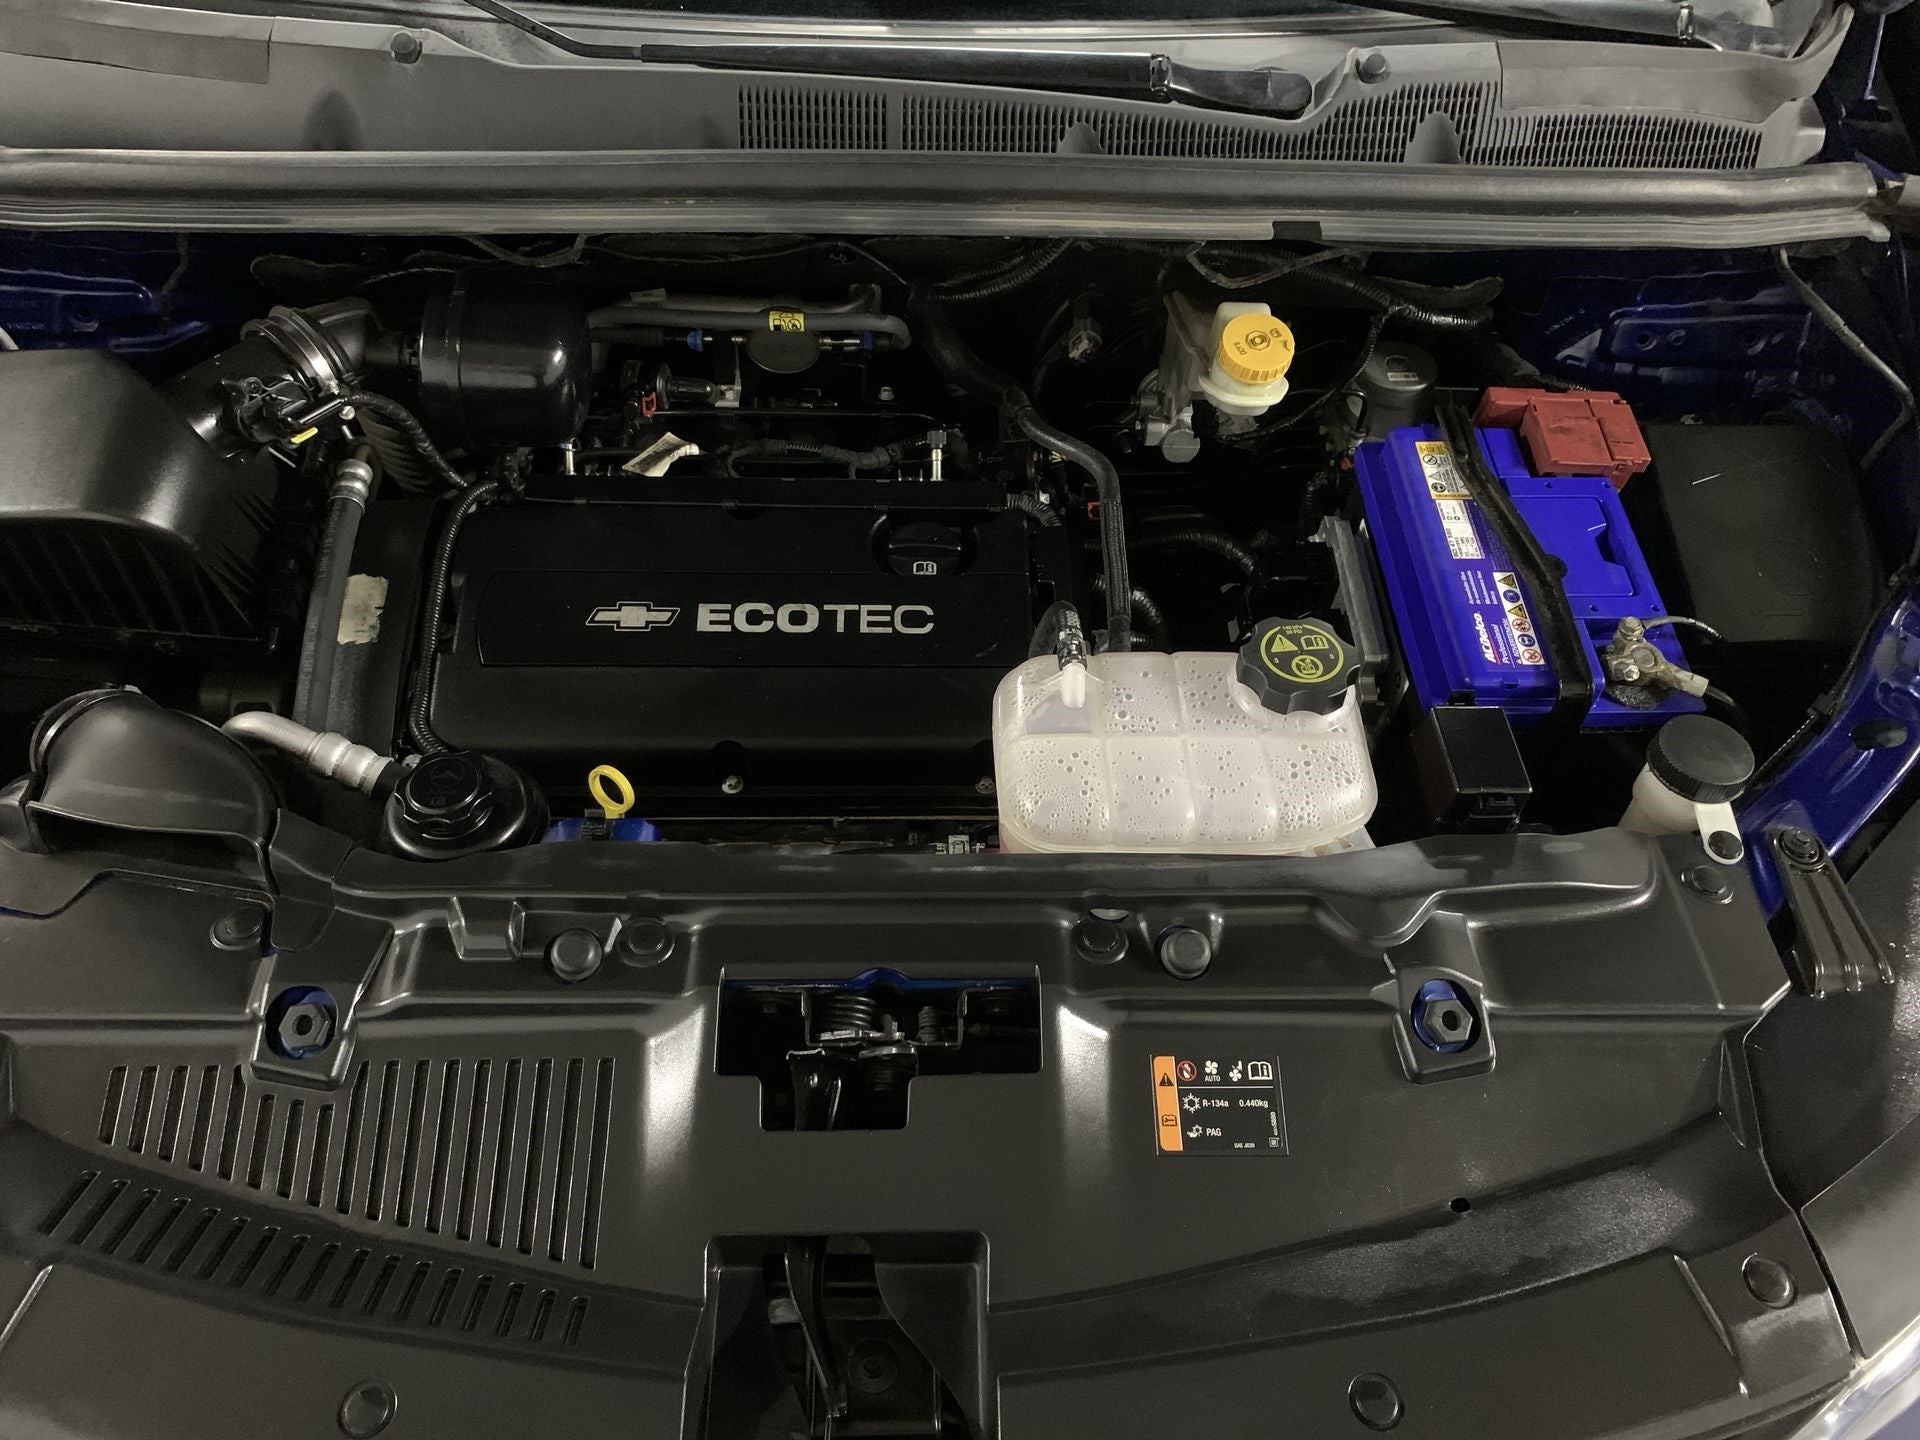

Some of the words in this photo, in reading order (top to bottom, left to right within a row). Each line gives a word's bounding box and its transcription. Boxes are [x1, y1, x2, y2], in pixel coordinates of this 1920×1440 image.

[696, 602, 934, 634] ECOTEC
[1473, 612, 1497, 663] ACDelco
[1490, 623, 1510, 664] Professional
[1202, 1098, 1229, 1107] R-134a
[1239, 1098, 1269, 1109] 0.440kg
[1206, 1128, 1222, 1137] PAG
